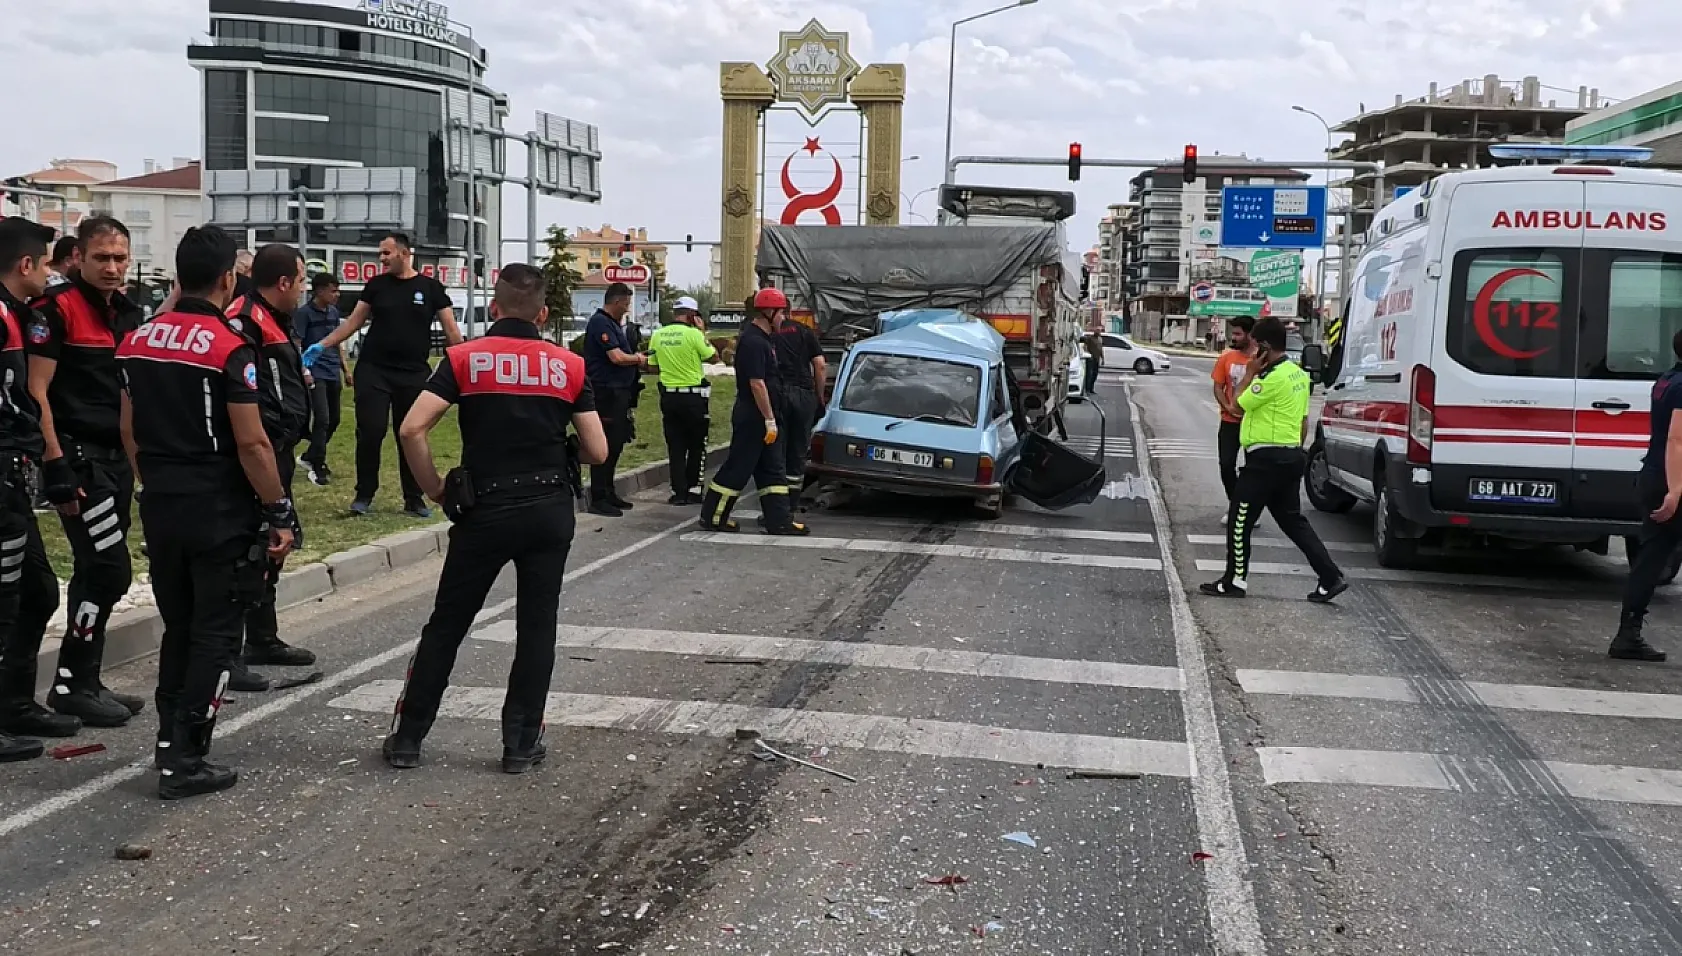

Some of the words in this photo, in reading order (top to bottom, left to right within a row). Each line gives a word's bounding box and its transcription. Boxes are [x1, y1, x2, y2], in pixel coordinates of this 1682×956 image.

[367, 13, 412, 33] HOTELS
[414, 20, 421, 34] &
[423, 24, 458, 44] LOUNGE
[788, 76, 837, 85] AKSARAY
[1233, 194, 1263, 203] Konya
[1233, 204, 1261, 213] Niğde
[1492, 210, 1667, 231] AMBULANS
[1492, 302, 1559, 330] 112
[131, 322, 215, 355] POLİS
[1381, 321, 1397, 360] 112
[469, 350, 567, 390] POLİS
[874, 448, 886, 460] 06
[913, 453, 932, 467] 017
[1478, 481, 1494, 494] 68
[1501, 482, 1524, 497] AAT
[1531, 484, 1554, 498] 737
